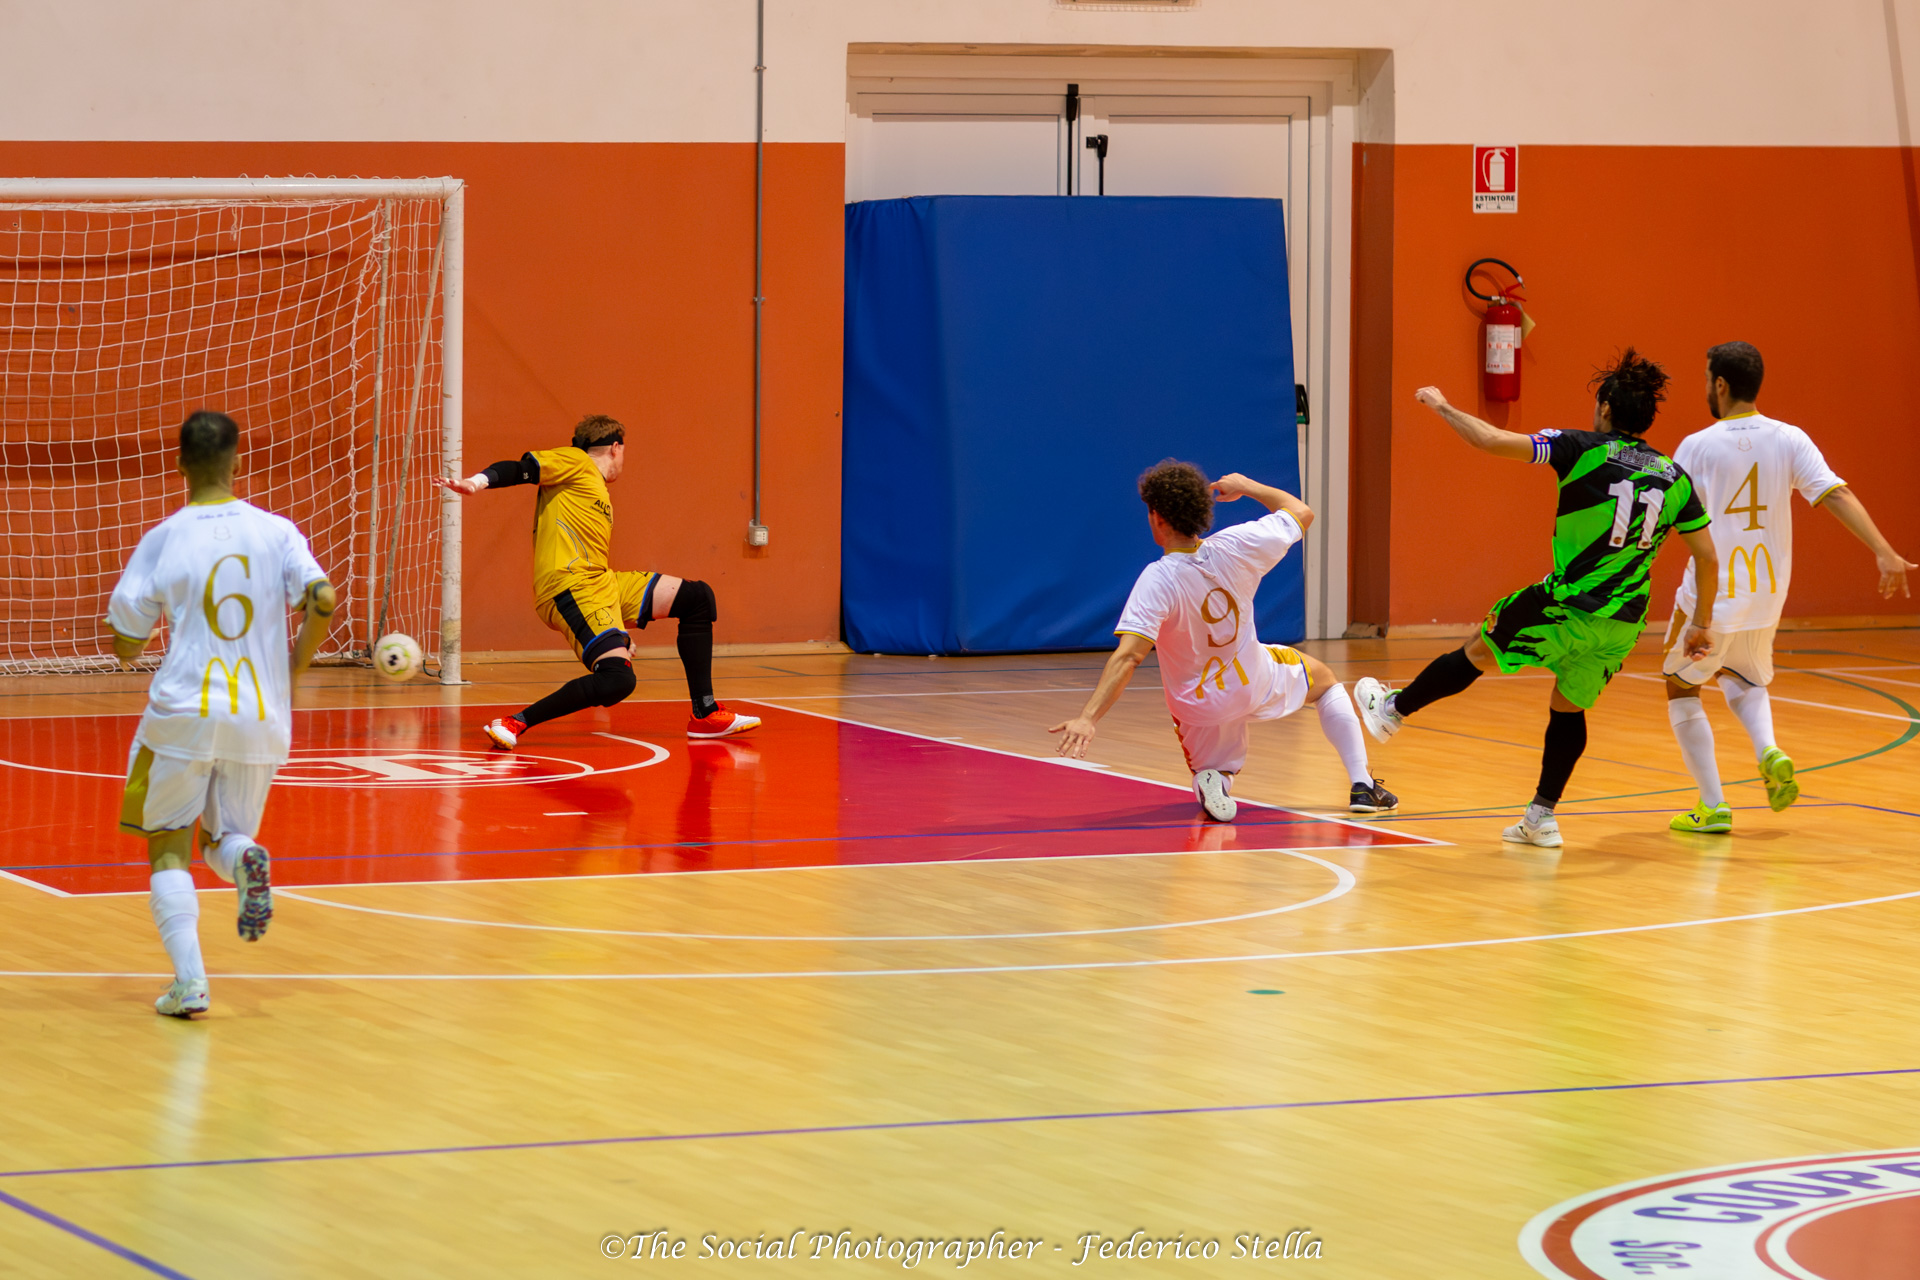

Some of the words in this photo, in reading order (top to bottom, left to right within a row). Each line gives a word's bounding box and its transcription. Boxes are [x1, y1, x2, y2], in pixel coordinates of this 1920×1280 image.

[1608, 479, 1664, 549] 11
[1724, 462, 1767, 531] 4
[203, 554, 254, 642] 6
[1201, 587, 1240, 648] 9
